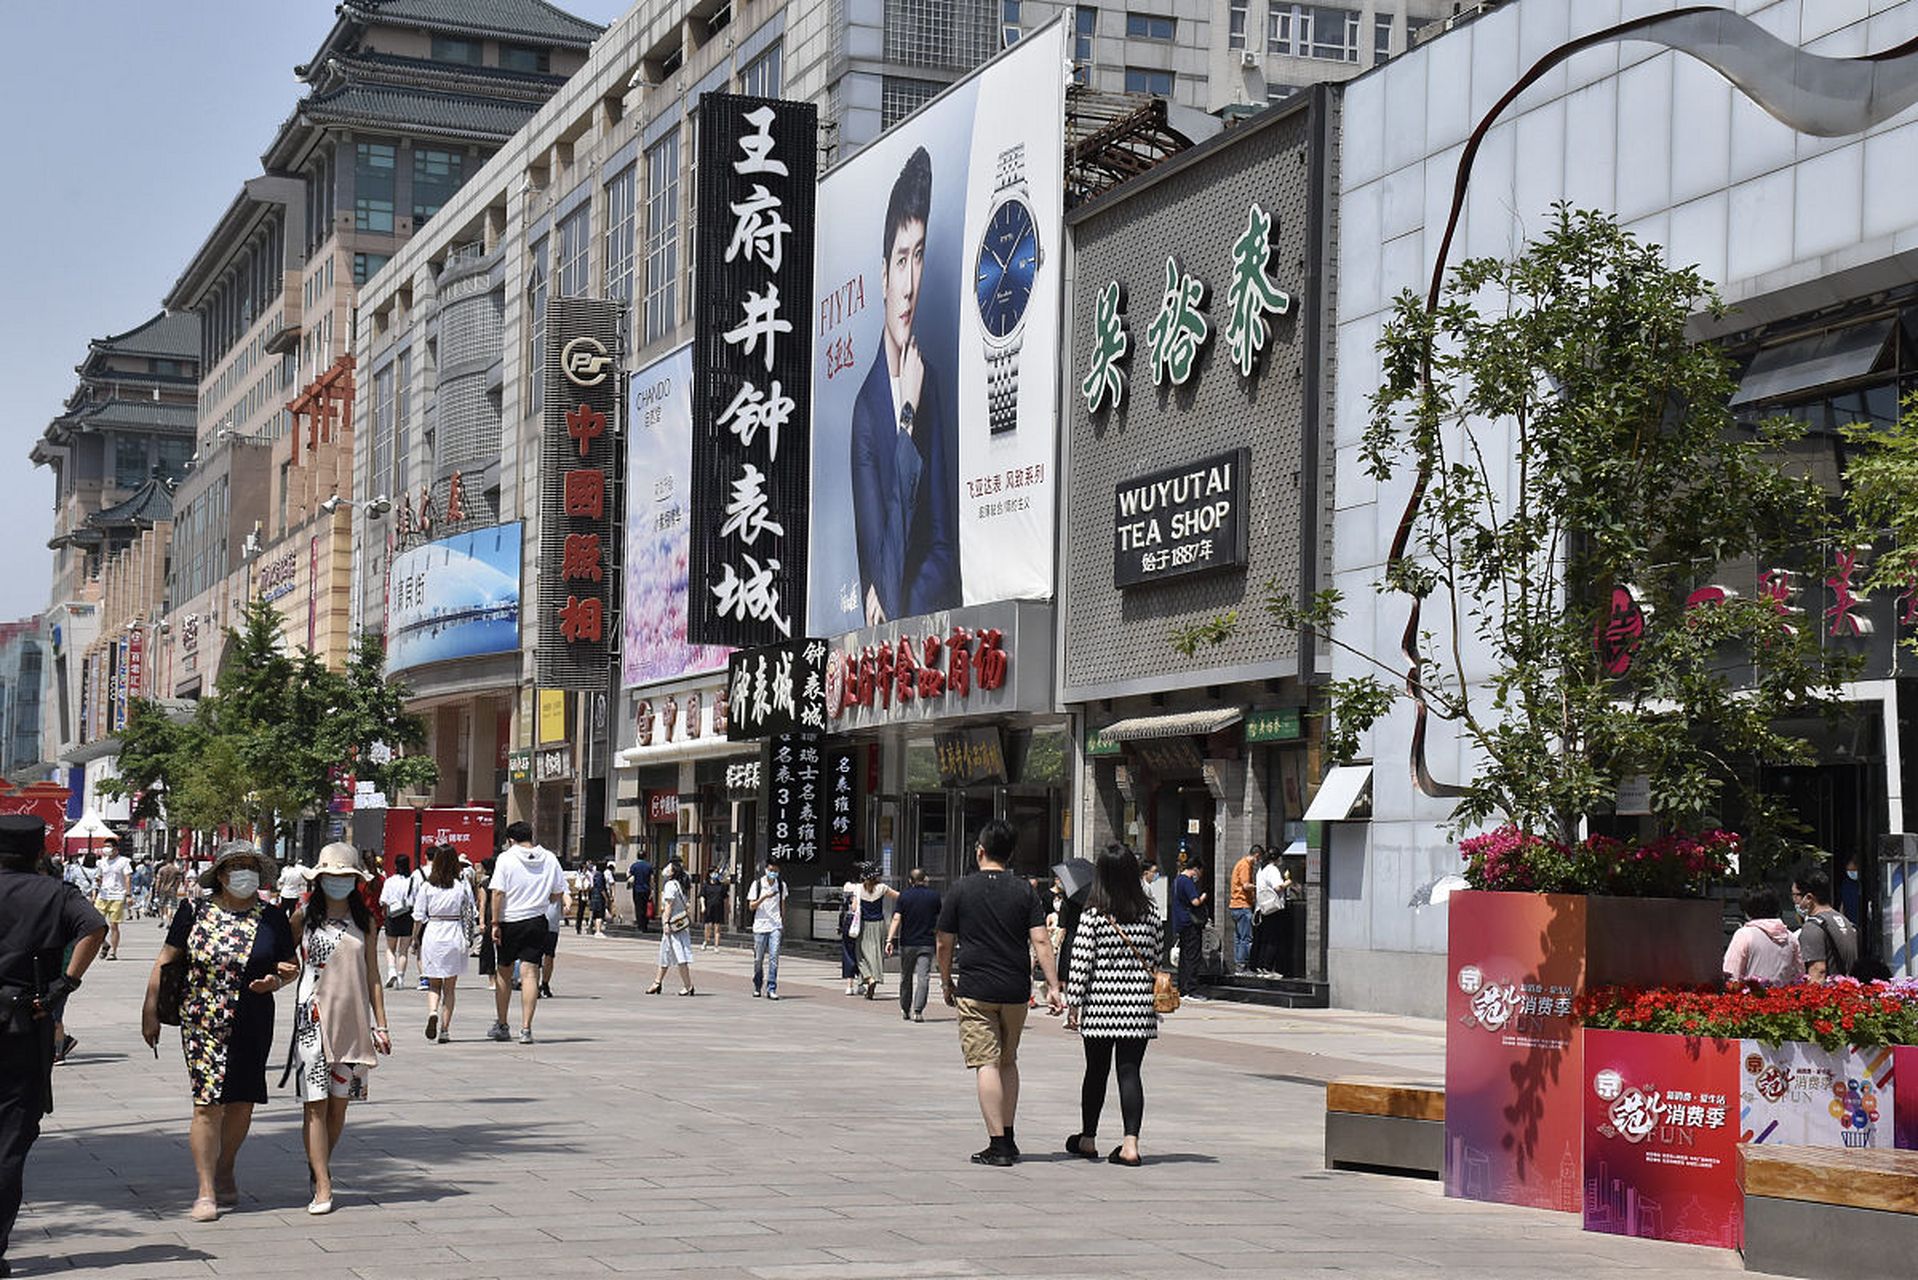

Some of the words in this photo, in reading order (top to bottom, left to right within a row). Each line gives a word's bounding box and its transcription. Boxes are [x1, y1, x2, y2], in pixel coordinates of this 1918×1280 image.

[820, 273, 865, 337] FIYTA
[1082, 203, 1290, 413] 吴裕泰
[711, 105, 795, 638] 王府井钟表城
[1119, 463, 1231, 517] WUYUTAI
[1118, 518, 1162, 551] TEA
[1170, 501, 1230, 539] SHOP
[1141, 539, 1213, 572] 始于1887年
[1461, 969, 1480, 991] 京
[1519, 995, 1572, 1017] 消费季
[1598, 1071, 1619, 1097] 京
[1665, 1104, 1726, 1129] 消费季
